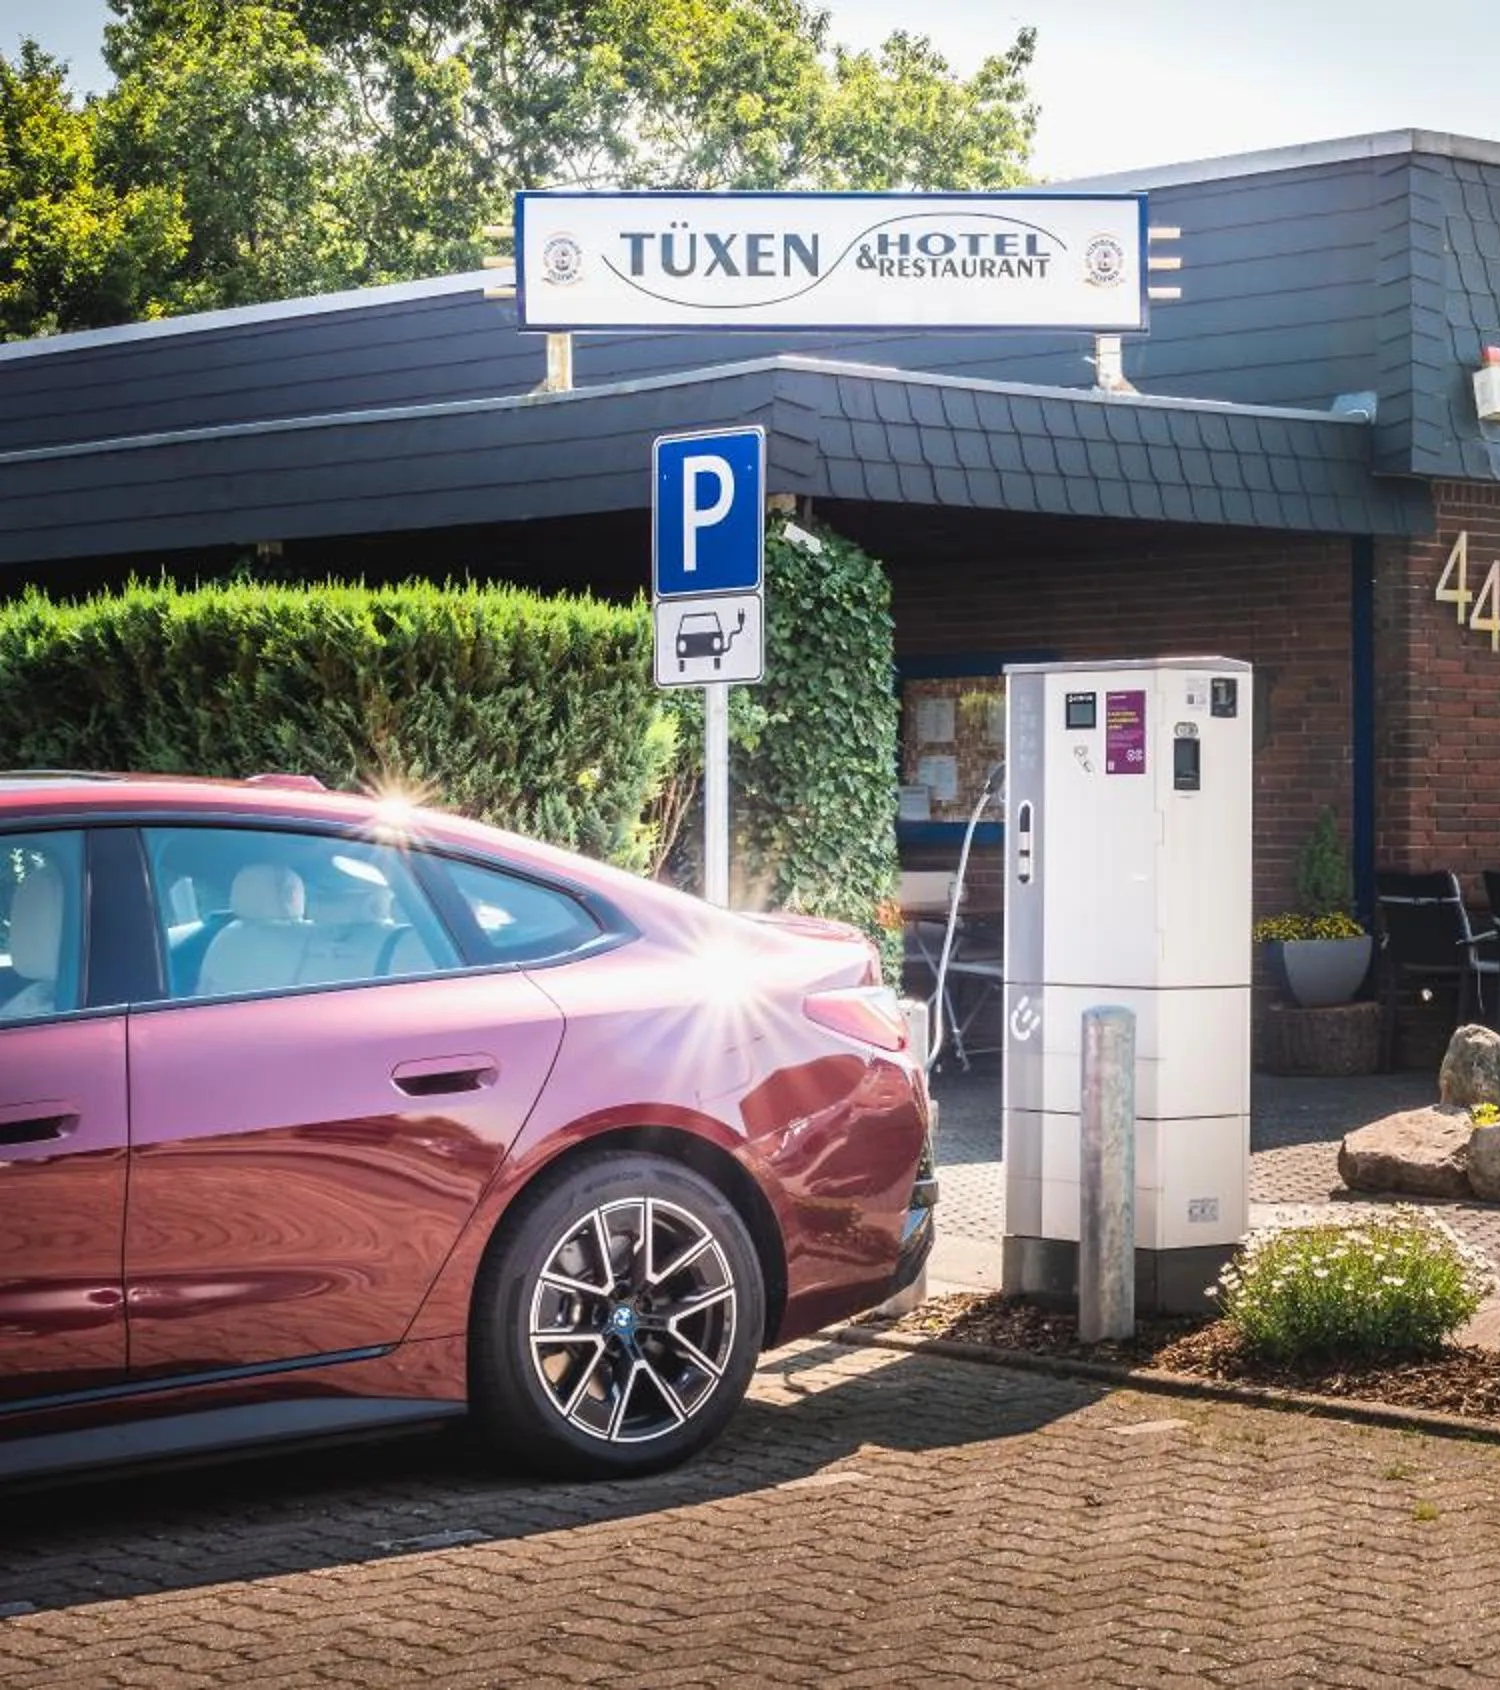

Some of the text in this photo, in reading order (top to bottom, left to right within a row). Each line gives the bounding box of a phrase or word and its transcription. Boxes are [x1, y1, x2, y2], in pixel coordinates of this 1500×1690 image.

[620, 221, 819, 277] TÜXEN
[877, 232, 1050, 256] HOTEL
[879, 258, 1050, 278] RESTAURANT
[683, 455, 735, 572] P
